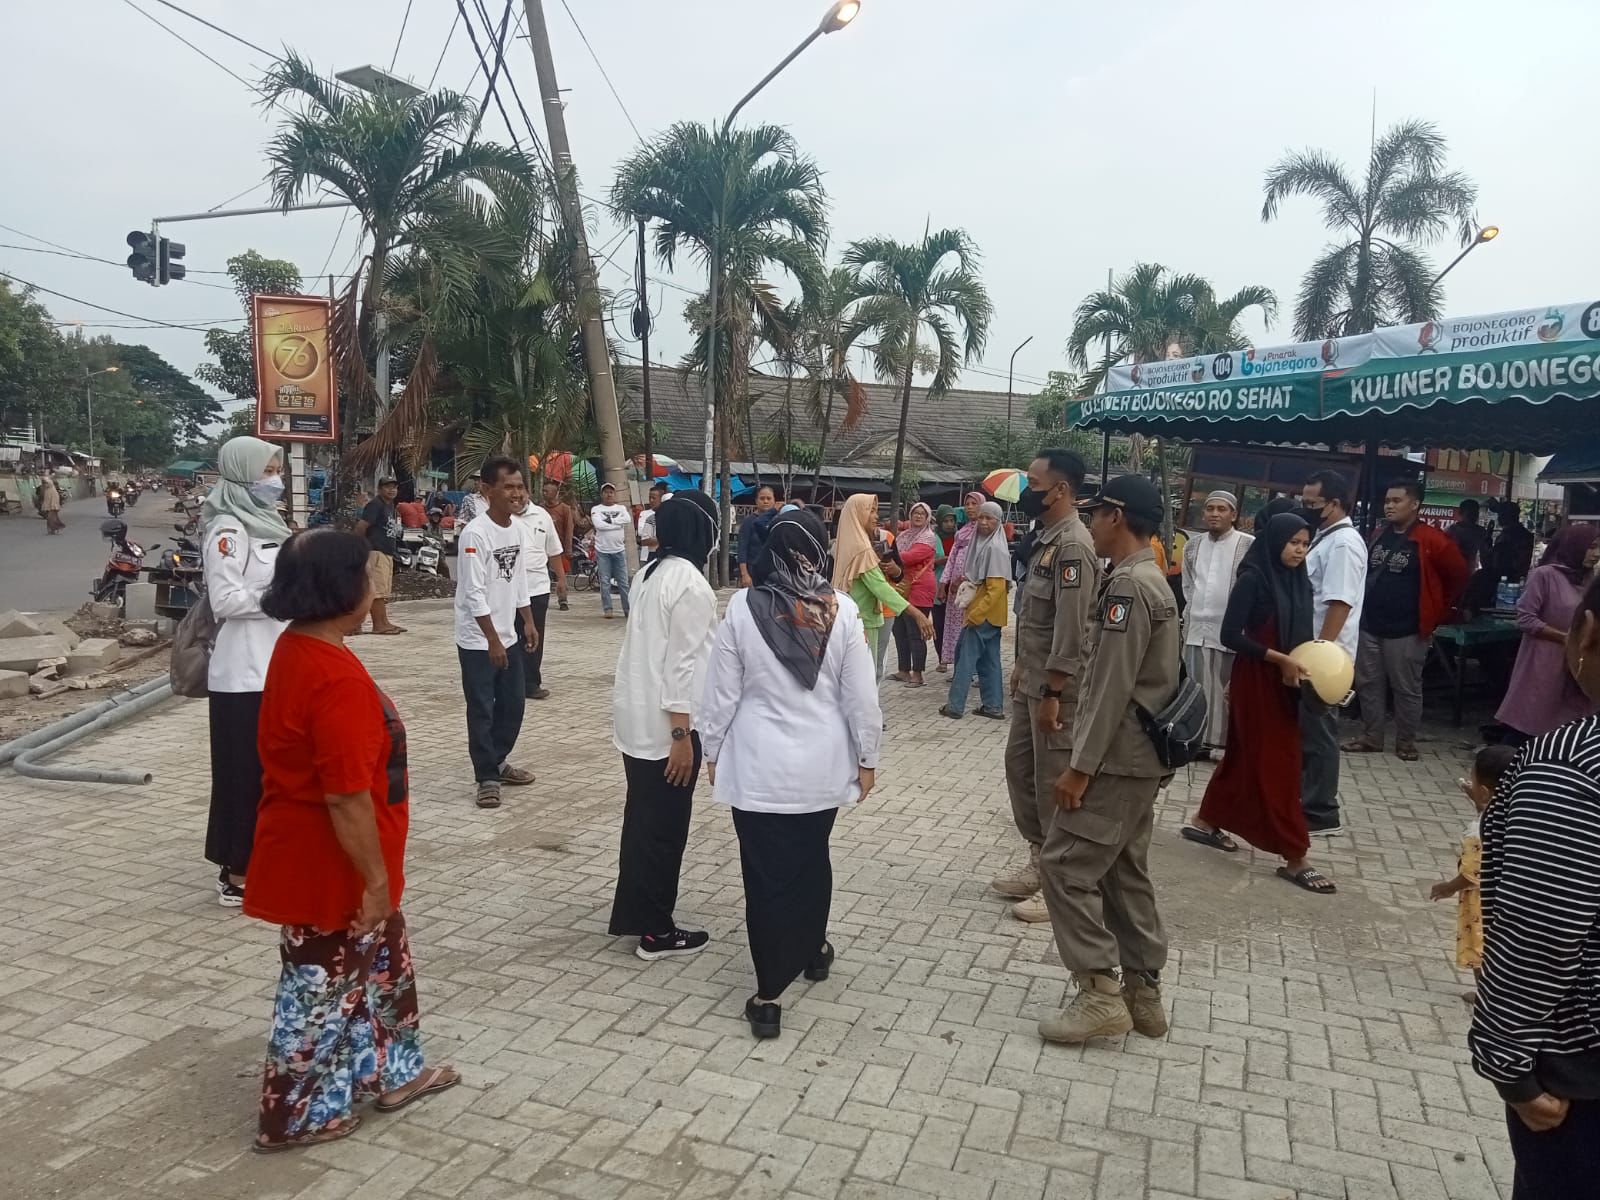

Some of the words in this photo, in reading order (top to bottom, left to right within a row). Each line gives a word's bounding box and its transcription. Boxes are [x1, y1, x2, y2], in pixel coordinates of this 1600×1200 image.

[1452, 315, 1536, 333] BOJONEGORO
[1451, 325, 1533, 351] produktif
[1147, 362, 1191, 374] BOJONEGORO
[1214, 357, 1231, 376] 104
[1147, 371, 1188, 386] produktif
[1349, 366, 1452, 403] KULINER
[1237, 385, 1293, 410] SEHAT
